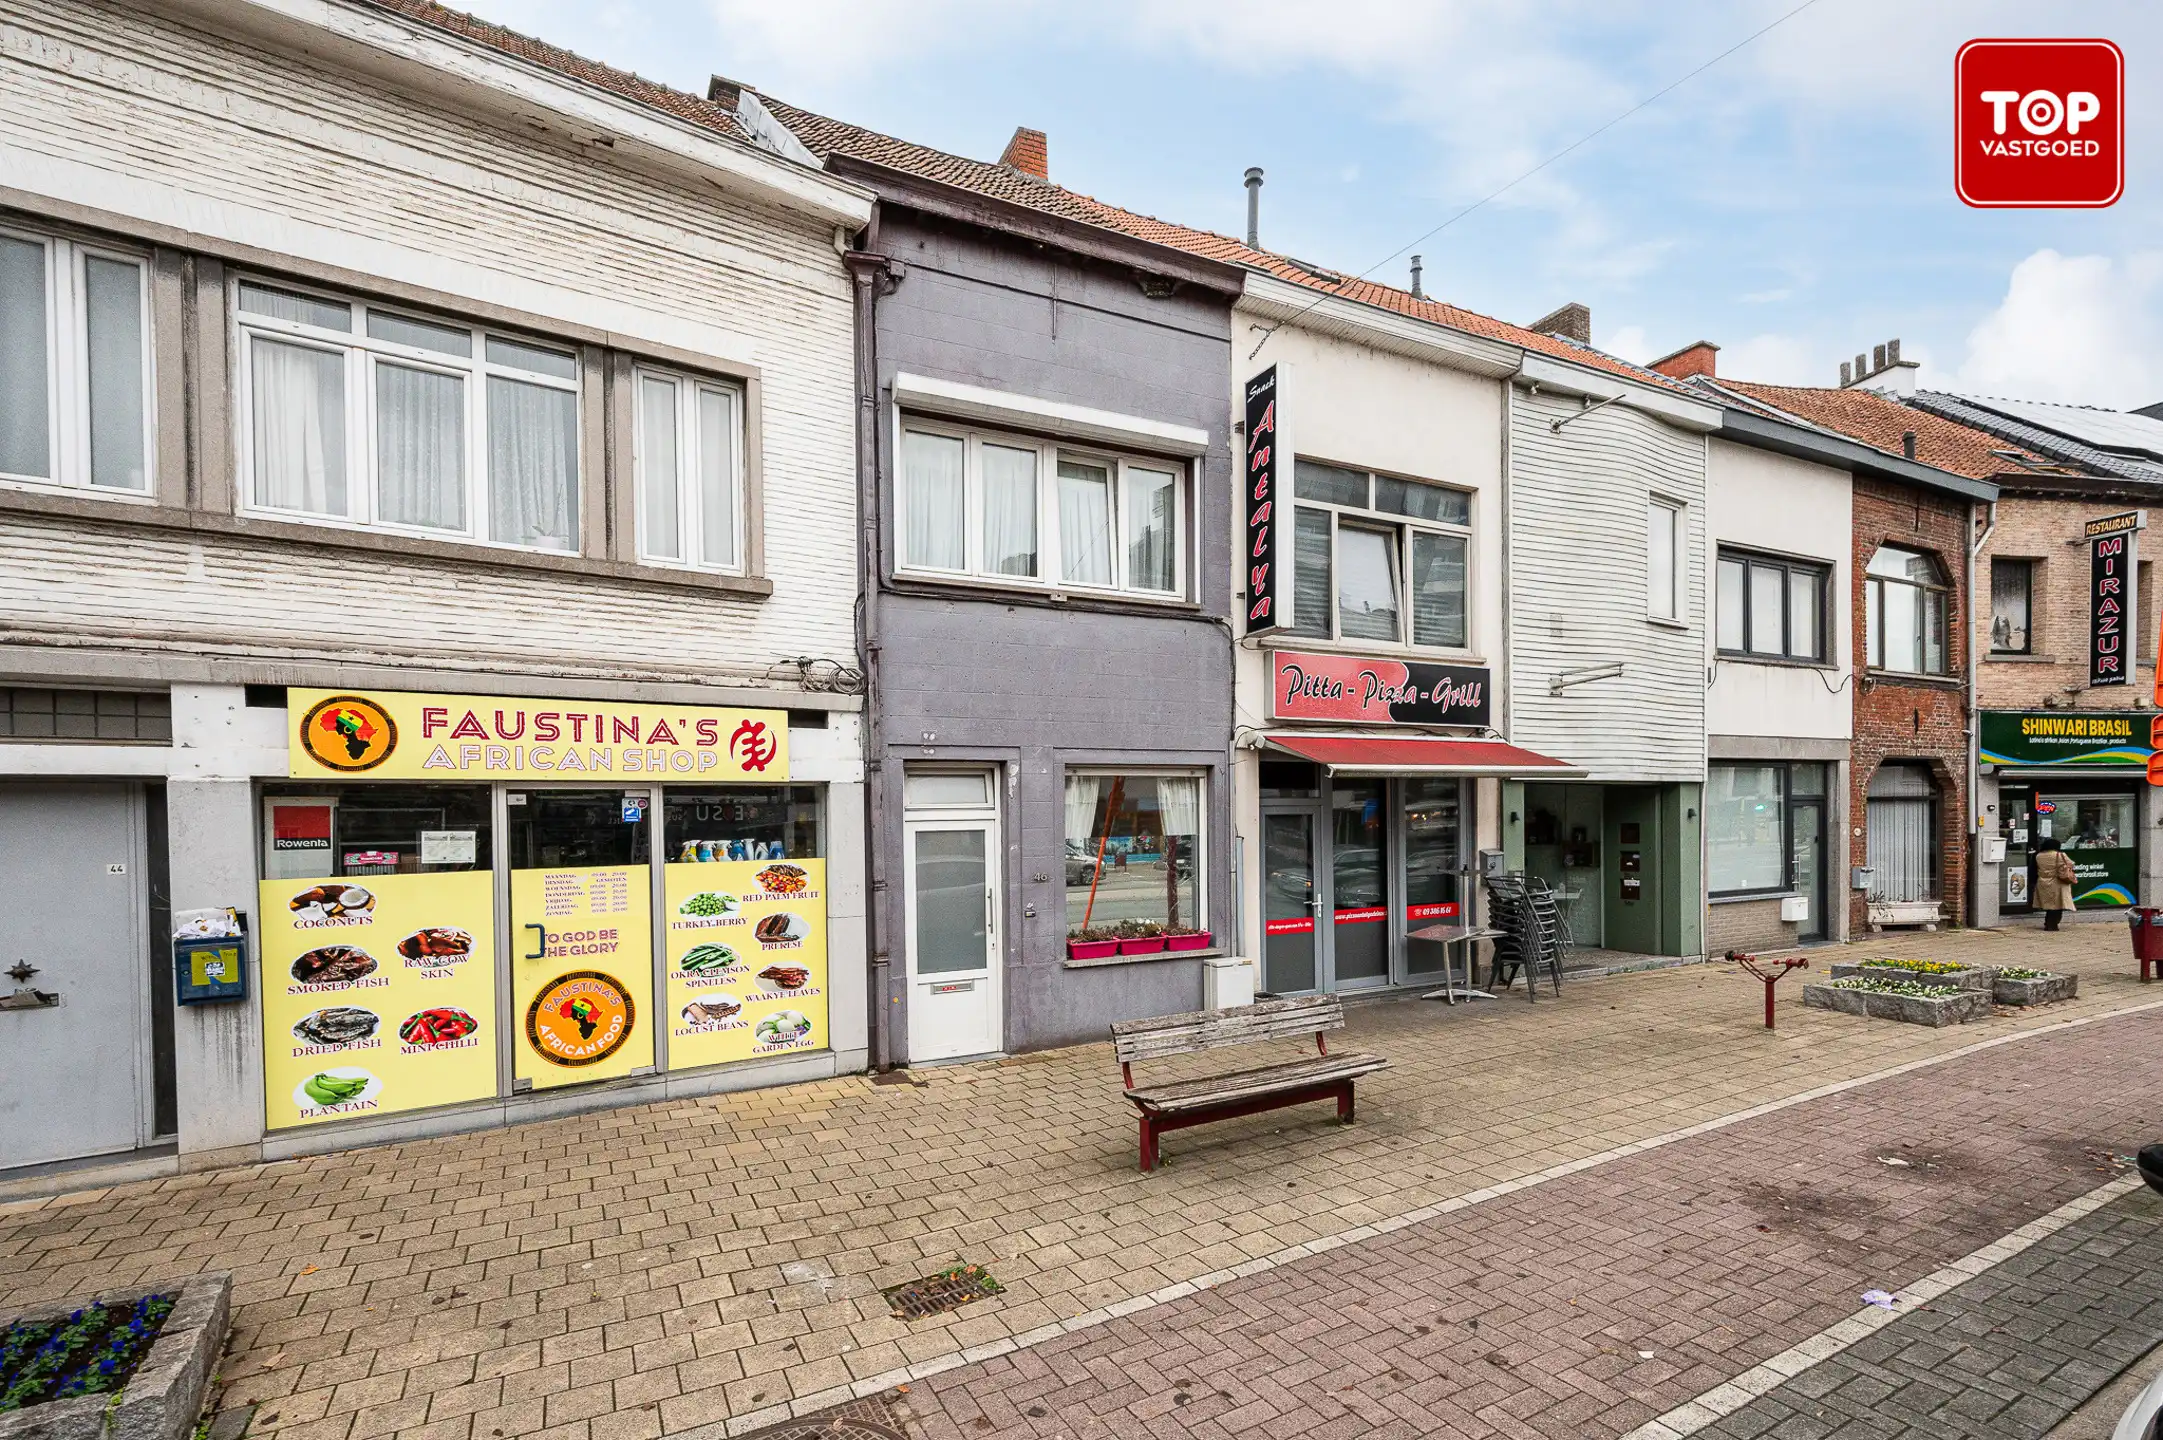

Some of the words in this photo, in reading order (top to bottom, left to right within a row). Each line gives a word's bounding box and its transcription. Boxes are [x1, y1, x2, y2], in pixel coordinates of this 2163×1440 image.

[1247, 374, 1275, 403] Snack
[1248, 399, 1275, 619] Antalya
[2086, 514, 2138, 536] RESTAURANT
[2098, 537, 2122, 674] MIRAZUR
[1281, 663, 1343, 706] Pitta
[1358, 669, 1416, 710] Pizza
[1432, 676, 1482, 713] Grill
[423, 707, 718, 746] FAUSTINA'S
[2022, 718, 2087, 735] SHINWARI
[2089, 719, 2133, 736] BRASIL
[422, 744, 613, 772] AFRICAN
[623, 749, 718, 773] SHOP
[277, 839, 328, 848] Rowenta
[1034, 872, 1047, 881] 46
[742, 894, 762, 902] RED
[765, 892, 790, 901] PALM
[792, 891, 820, 899] FRUIT
[293, 916, 373, 929] COCONUTS
[671, 920, 712, 930] TURKEY
[716, 918, 748, 927] BERRY
[562, 931, 596, 943] GOD
[599, 928, 618, 940] BE
[569, 941, 619, 956] GLORY
[762, 941, 803, 950] PREKESE
[404, 957, 434, 969] RAW
[438, 954, 469, 966] COW
[421, 968, 454, 979] SKIN
[671, 970, 700, 980] OKRA
[703, 965, 750, 976] CLEMSON
[287, 980, 351, 995] SMOKED
[355, 977, 389, 989] FISH
[685, 977, 737, 988] SPINELESS
[543, 982, 622, 1013] FAUSTINA'S
[745, 991, 785, 1003] WAAKYE
[788, 987, 821, 998] LEAVES
[540, 1024, 597, 1056] AFRICAN
[597, 1014, 623, 1049] FOOD
[675, 1025, 714, 1036] LOCUST
[717, 1020, 749, 1031] BEANS
[292, 1042, 343, 1057] DRIED
[348, 1038, 381, 1051] FISH
[400, 1043, 431, 1055] MINI
[435, 1038, 479, 1051] CHILLI
[752, 1042, 792, 1054] GARDEN
[795, 1039, 814, 1048] EGG
[300, 1100, 378, 1119] PLANTAIN
